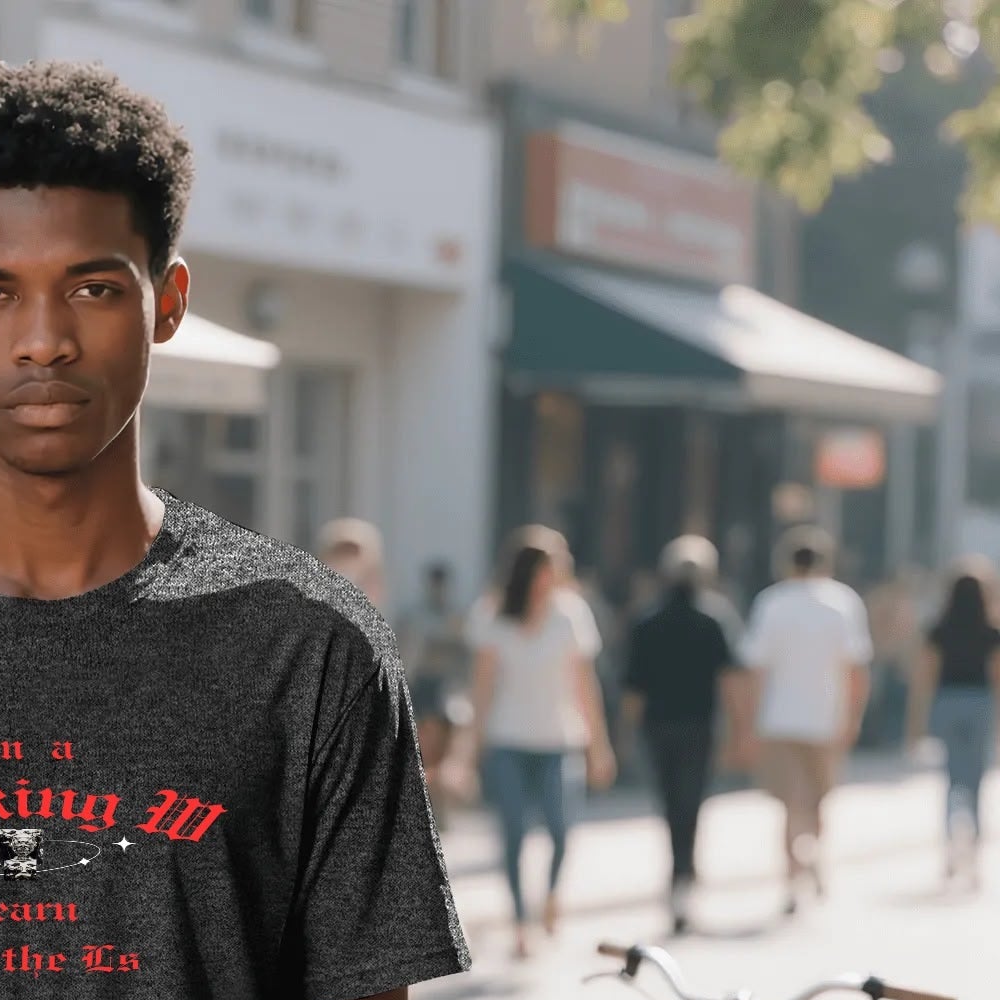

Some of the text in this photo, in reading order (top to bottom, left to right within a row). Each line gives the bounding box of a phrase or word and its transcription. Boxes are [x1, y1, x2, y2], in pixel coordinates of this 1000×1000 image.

[51, 741, 74, 761] a
[136, 788, 227, 843] W
[2, 944, 68, 977] the
[81, 944, 140, 973] Ls
